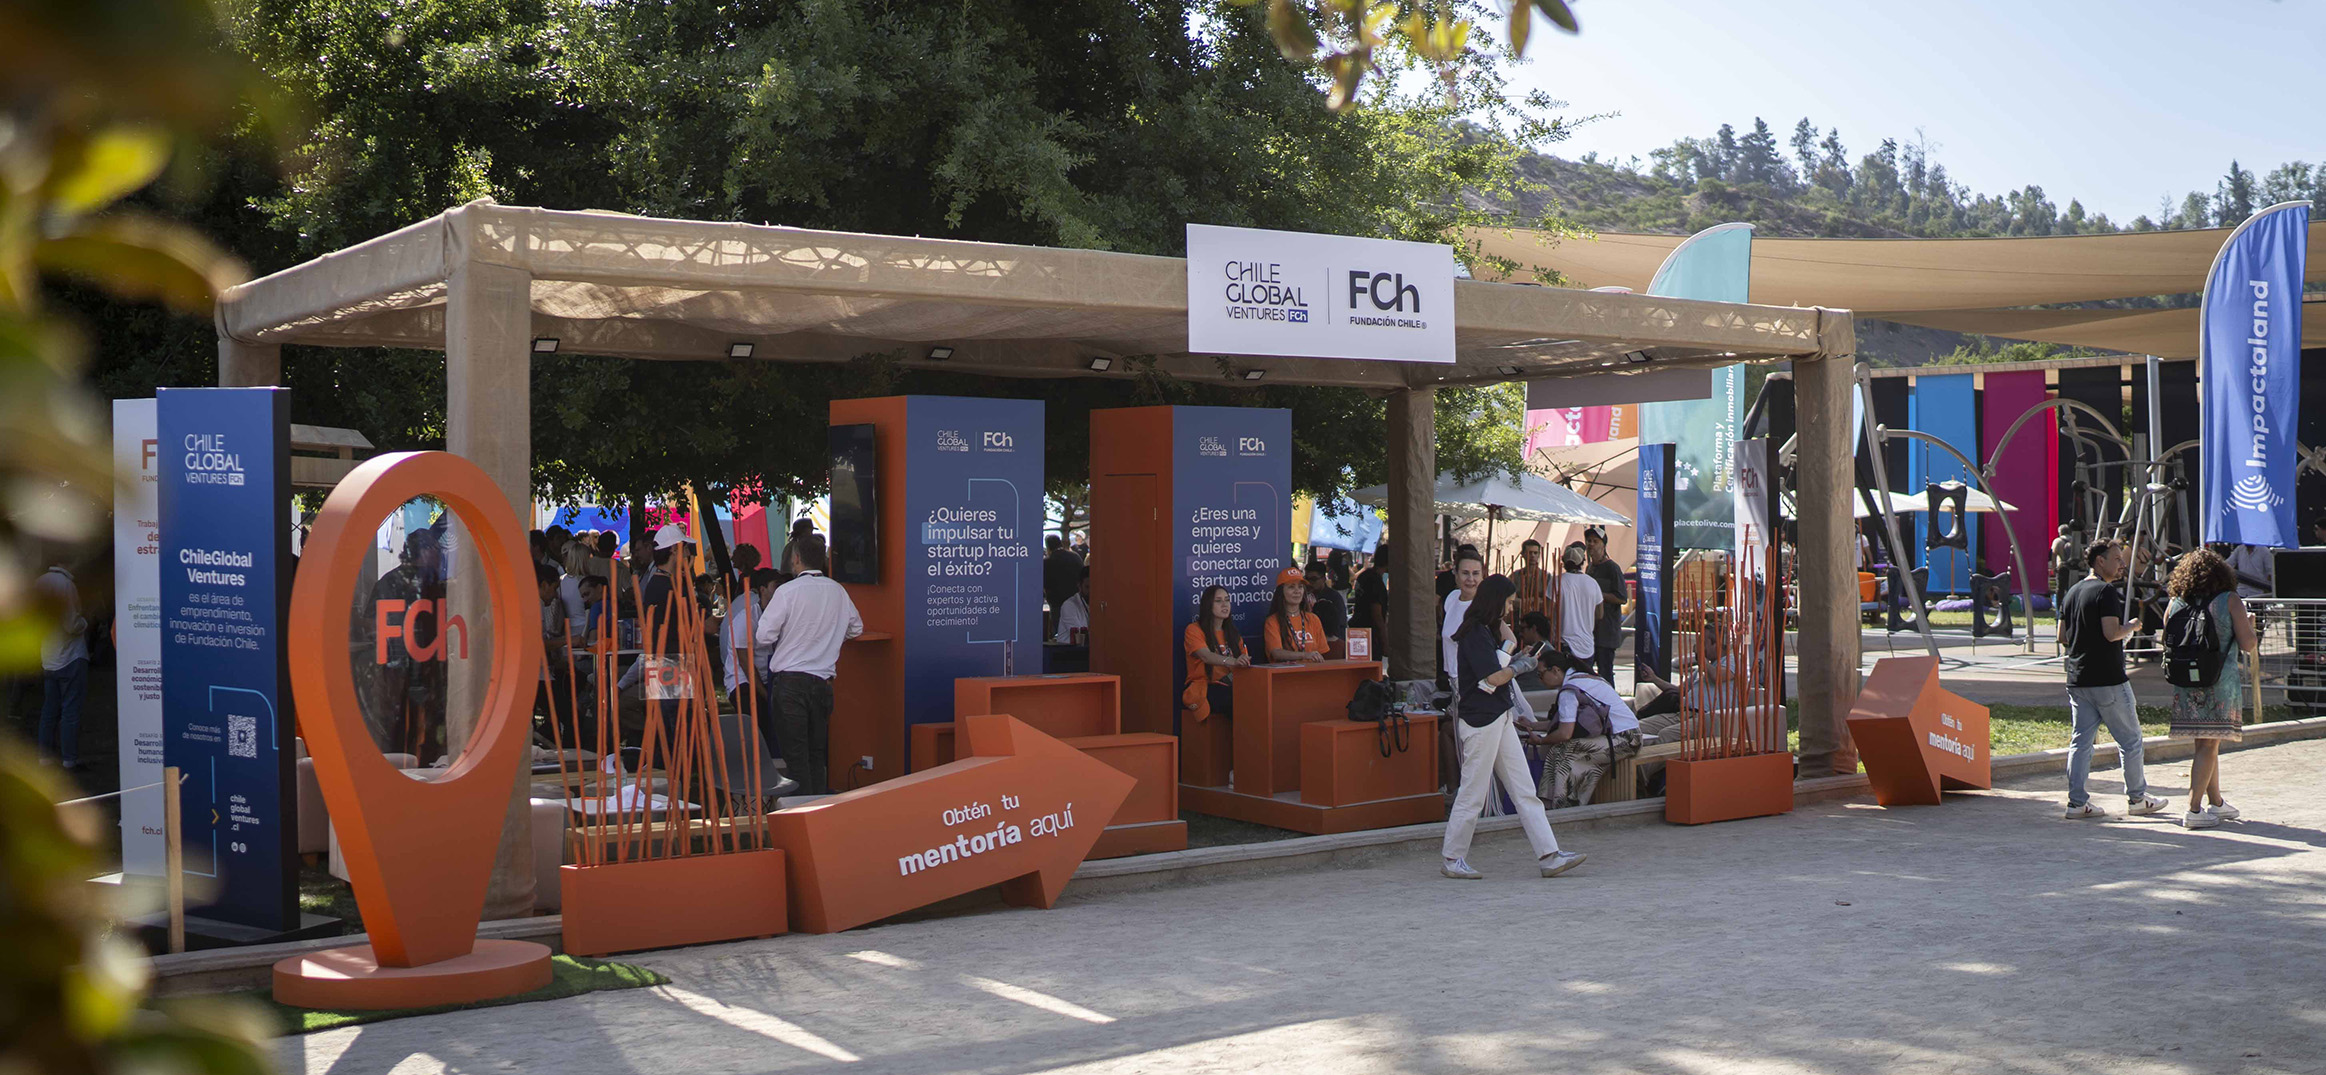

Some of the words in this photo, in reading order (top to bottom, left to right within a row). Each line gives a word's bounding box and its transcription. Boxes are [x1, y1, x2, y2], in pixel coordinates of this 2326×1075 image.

[1225, 261, 1281, 284] CHILE
[1225, 283, 1308, 307] GLOBAL
[1348, 270, 1421, 314] FCh
[1226, 306, 1286, 321] VENTURES
[1289, 310, 1307, 322] FCh
[1349, 316, 1396, 327] FUNDACIÓN
[1397, 319, 1421, 329] CHILE
[2245, 280, 2270, 468] Impactaland
[1715, 422, 1725, 431] y
[937, 430, 958, 439] CHILE
[937, 438, 968, 446] GLOBAL
[983, 432, 1013, 447] FCh
[1200, 436, 1218, 444] CHILE
[184, 434, 224, 452] CHILE
[1200, 443, 1226, 451] GLOBAL
[1239, 437, 1265, 451] FCh
[184, 452, 244, 472] GLOBAL
[1713, 432, 1724, 492] Plataforma
[1725, 428, 1735, 493] Certificación
[185, 472, 227, 484] VENTURES
[928, 507, 996, 524] ¿Quieres
[1192, 507, 1229, 523] ¿Eres
[1232, 508, 1256, 520] una
[138, 519, 158, 529] Trabaj
[1674, 519, 1735, 529] placetolive.com
[928, 525, 993, 543] impulsar
[997, 526, 1013, 539] tu
[1192, 525, 1250, 540] empresa
[1252, 526, 1261, 540] y
[137, 544, 160, 554] estr
[927, 544, 984, 561] startup
[988, 542, 1029, 557] hacia
[1192, 540, 1241, 557] quieres
[180, 548, 252, 567] ChileGlobal
[1192, 557, 1251, 571] conectar
[1255, 558, 1279, 569] con
[927, 561, 941, 576] el
[945, 561, 993, 576] éxito?
[187, 568, 245, 586] Ventures
[1192, 574, 1248, 590] startups
[1251, 572, 1268, 585] de
[927, 584, 965, 595] ¡Conecta
[967, 585, 983, 593] con
[189, 593, 199, 602] es
[201, 593, 210, 603] el
[211, 592, 230, 605] área
[232, 595, 244, 605] de
[927, 596, 964, 606] expertos
[966, 597, 972, 605] y
[973, 594, 999, 604] activa
[180, 606, 253, 622] emprendimiento,
[927, 606, 987, 617] oportunidades
[989, 606, 1000, 614] de
[169, 617, 216, 632] innovación
[217, 624, 224, 632] e
[225, 622, 265, 636] inversión
[927, 617, 979, 626] crecimiento!
[376, 598, 468, 665] FCh
[175, 633, 186, 643] de
[188, 633, 232, 648] Fundación
[234, 637, 260, 650] Chile.
[131, 675, 162, 683] económic
[645, 666, 690, 686] FCh
[230, 794, 246, 804] chile
[230, 804, 251, 814] global
[942, 802, 991, 827] Obtén
[1001, 795, 1020, 811] tu
[231, 814, 259, 824] ventures
[142, 826, 162, 835] fch.cl
[898, 820, 1022, 876] mentoría
[1029, 803, 1075, 837] aquí
